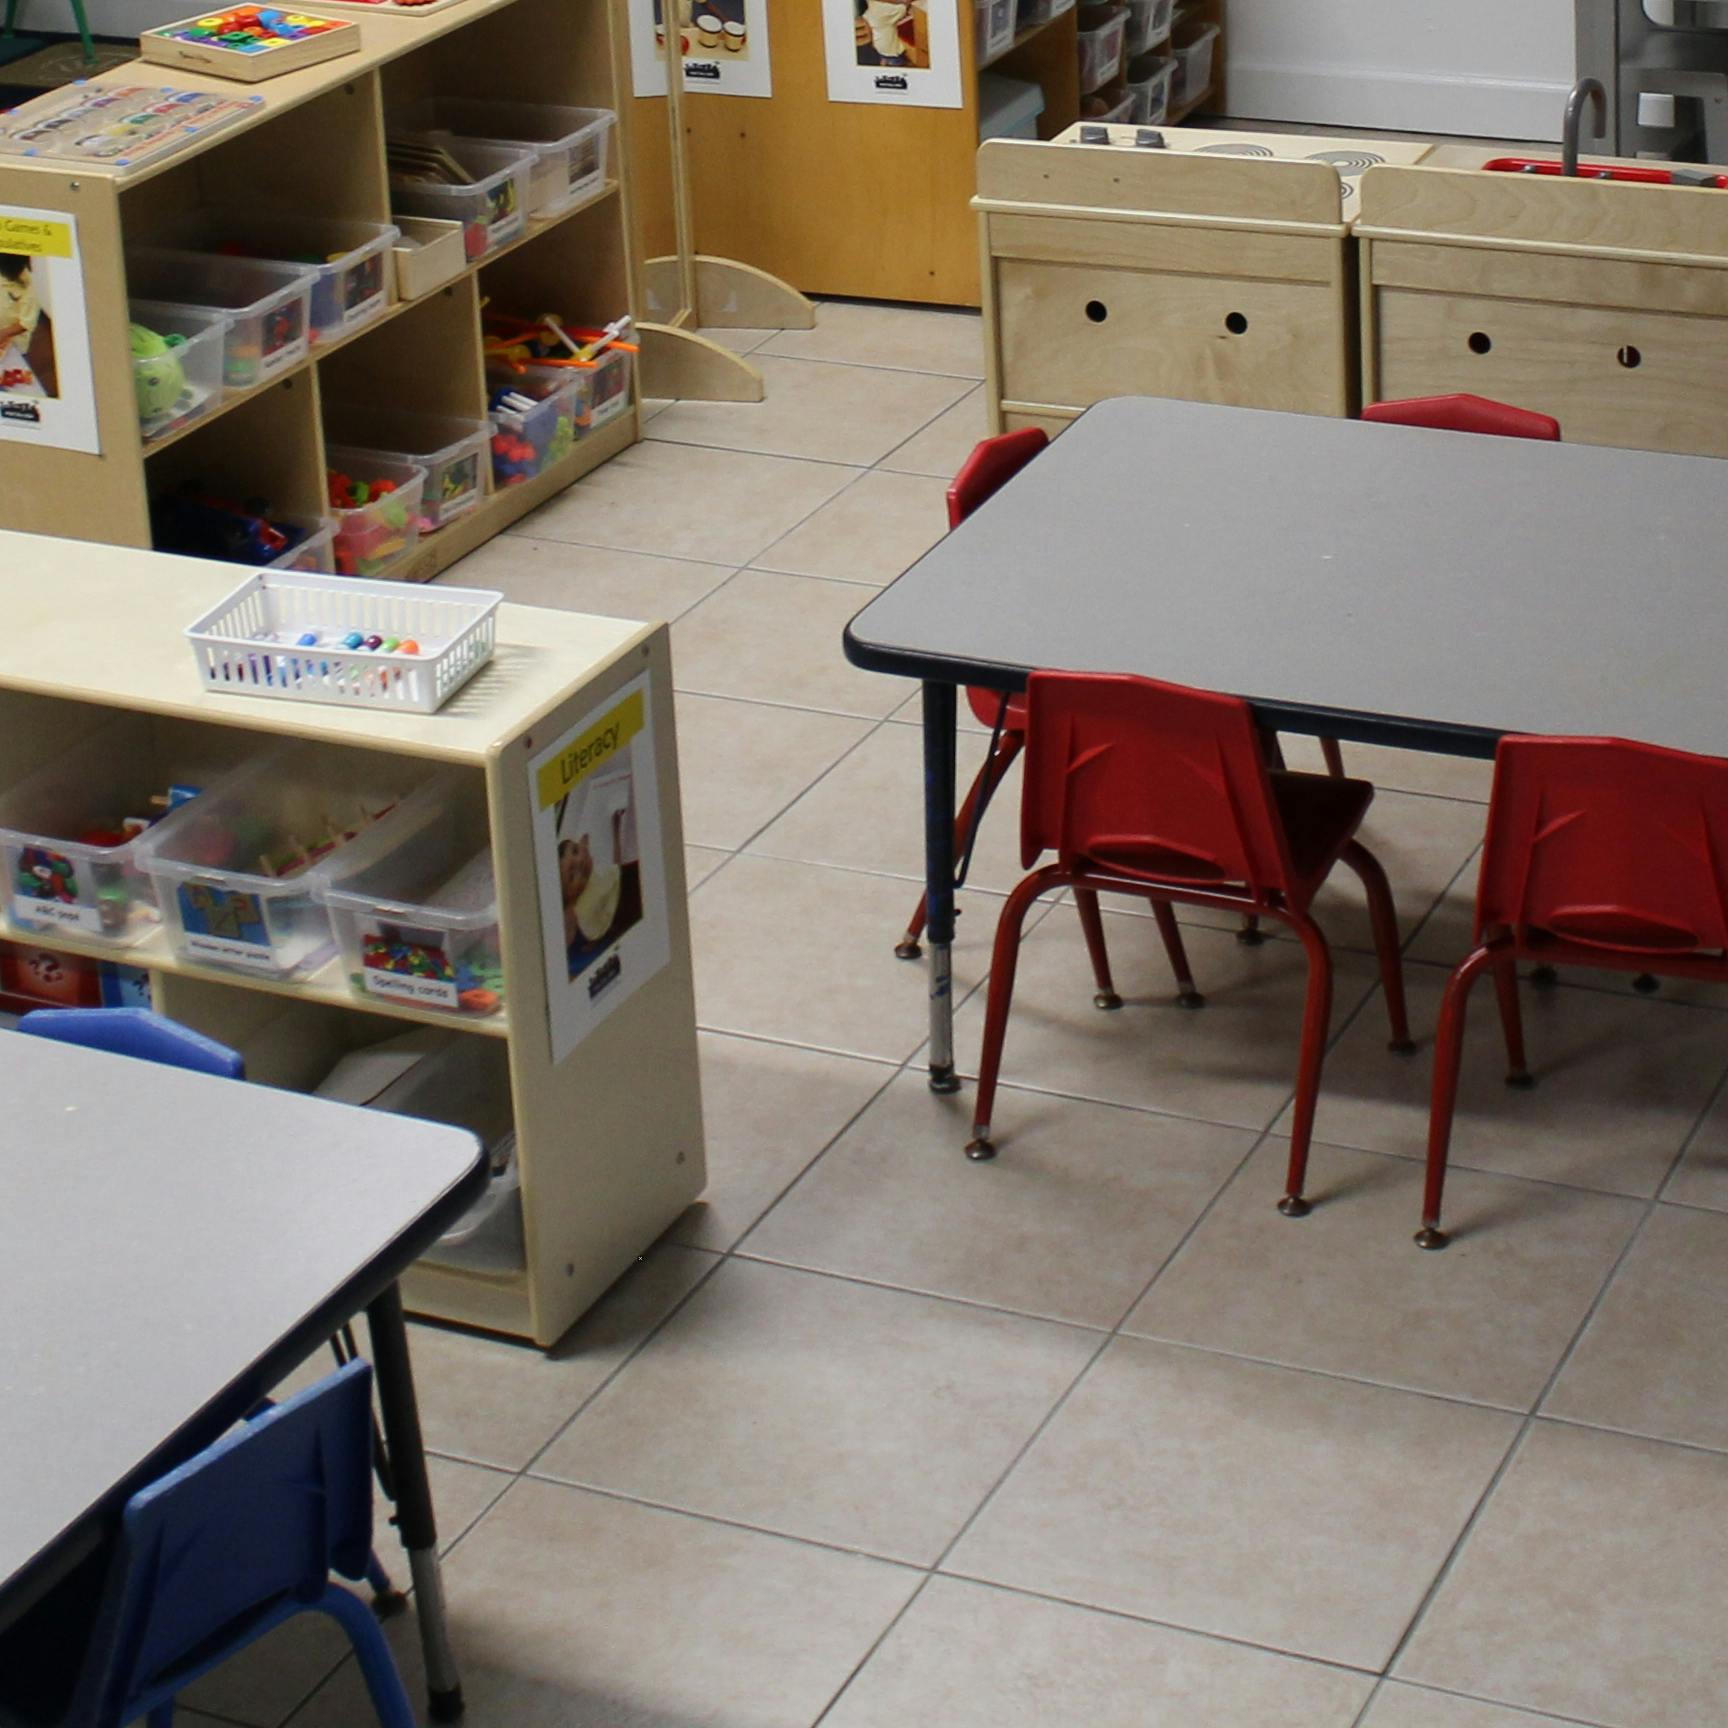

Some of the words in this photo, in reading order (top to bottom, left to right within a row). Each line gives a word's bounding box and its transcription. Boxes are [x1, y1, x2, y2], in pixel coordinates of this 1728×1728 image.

[3, 220, 40, 234] Games
[42, 224, 53, 236] &
[560, 722, 621, 784] Literacy
